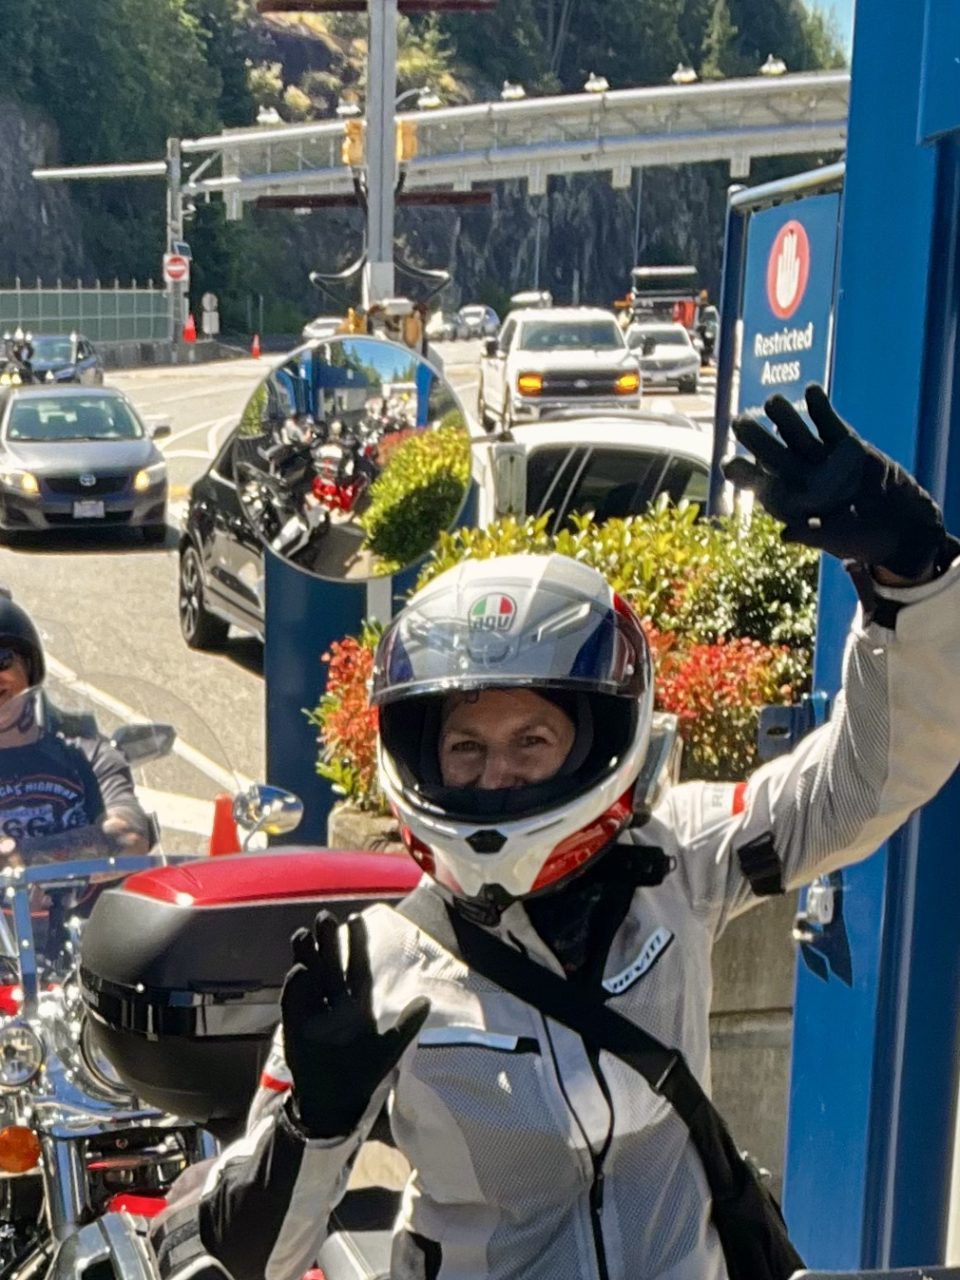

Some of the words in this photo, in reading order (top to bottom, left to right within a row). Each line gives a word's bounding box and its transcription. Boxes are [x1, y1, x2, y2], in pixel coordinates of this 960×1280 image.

[754, 321, 813, 357] Restricted
[761, 361, 800, 385] Access
[25, 781, 79, 800] HIGHWAY
